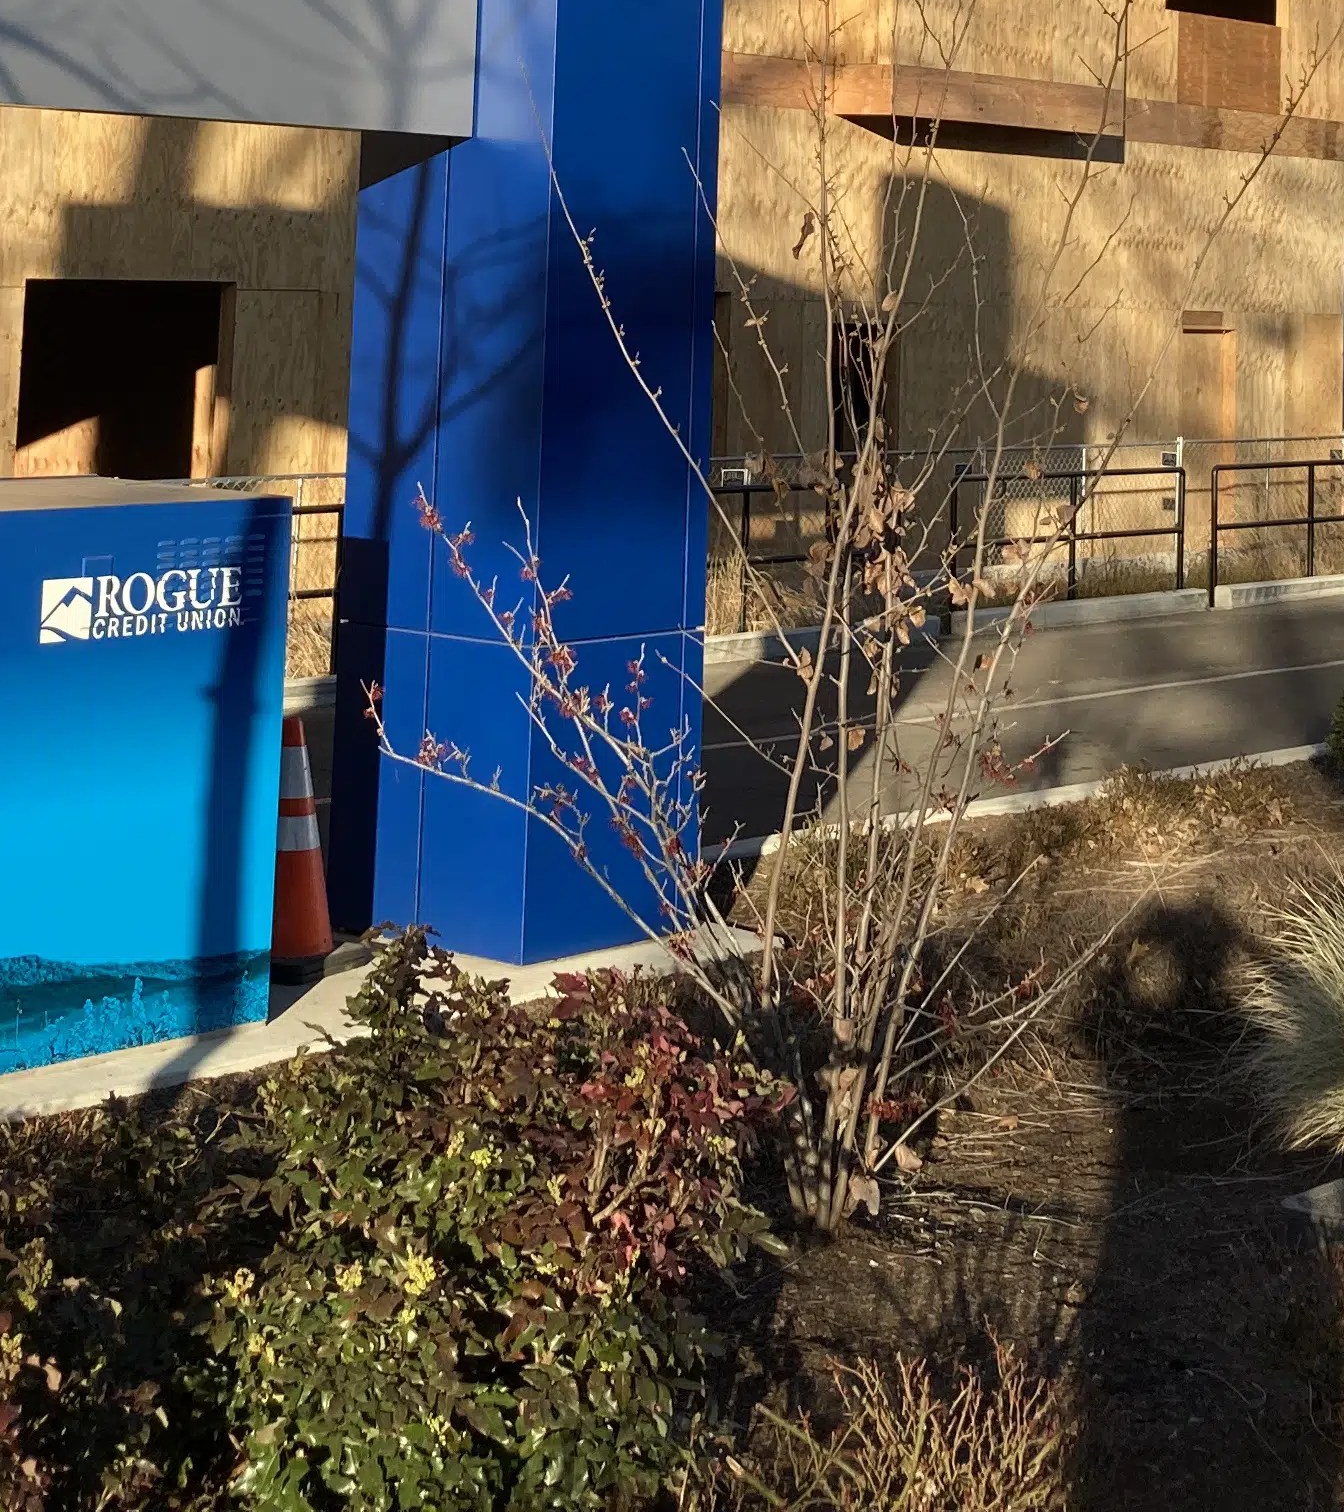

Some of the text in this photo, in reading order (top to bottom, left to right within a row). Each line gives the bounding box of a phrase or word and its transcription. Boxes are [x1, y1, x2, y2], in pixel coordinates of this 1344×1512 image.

[96, 567, 242, 617] ROGUE
[92, 608, 242, 640] CREDIT UNION
